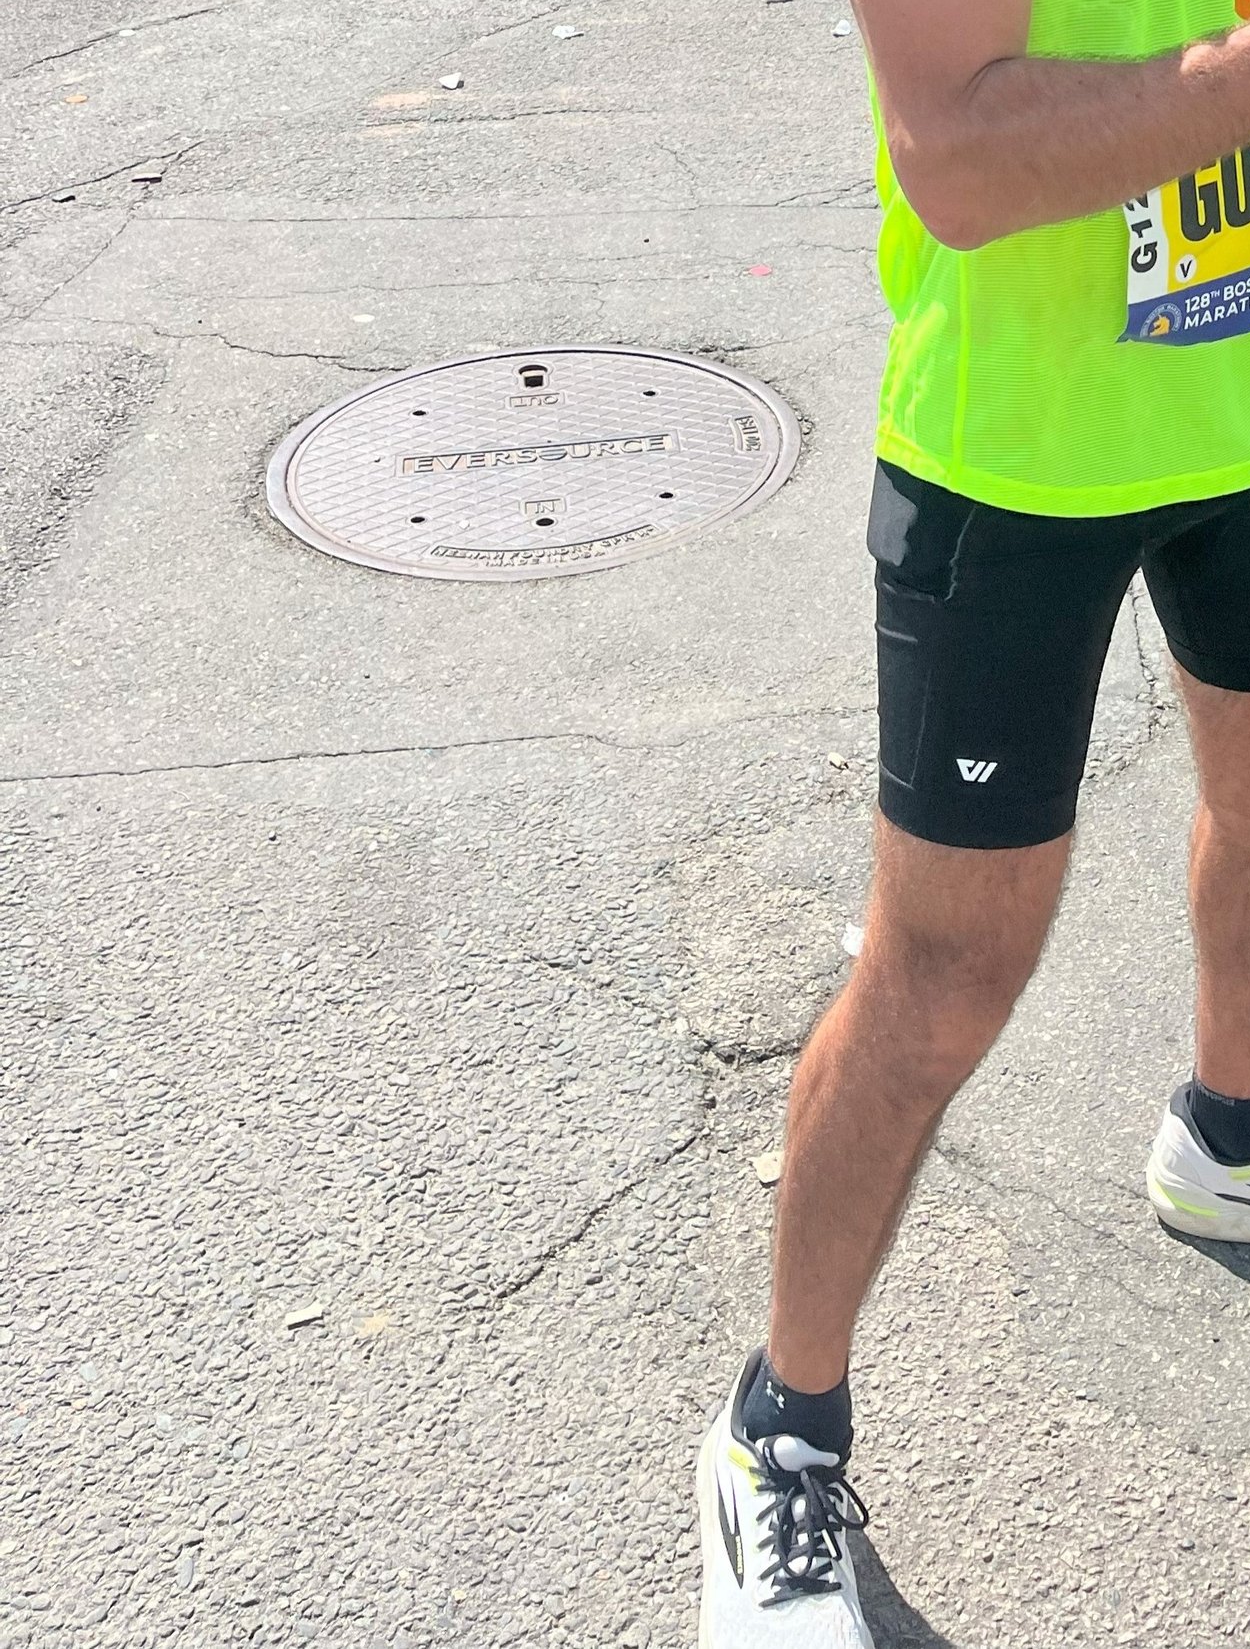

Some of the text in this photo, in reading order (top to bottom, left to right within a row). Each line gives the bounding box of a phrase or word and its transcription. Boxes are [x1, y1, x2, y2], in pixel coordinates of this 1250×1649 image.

[1179, 259, 1193, 279] V
[1185, 289, 1221, 314] 128TH
[414, 435, 665, 473] EVERSOURCE
